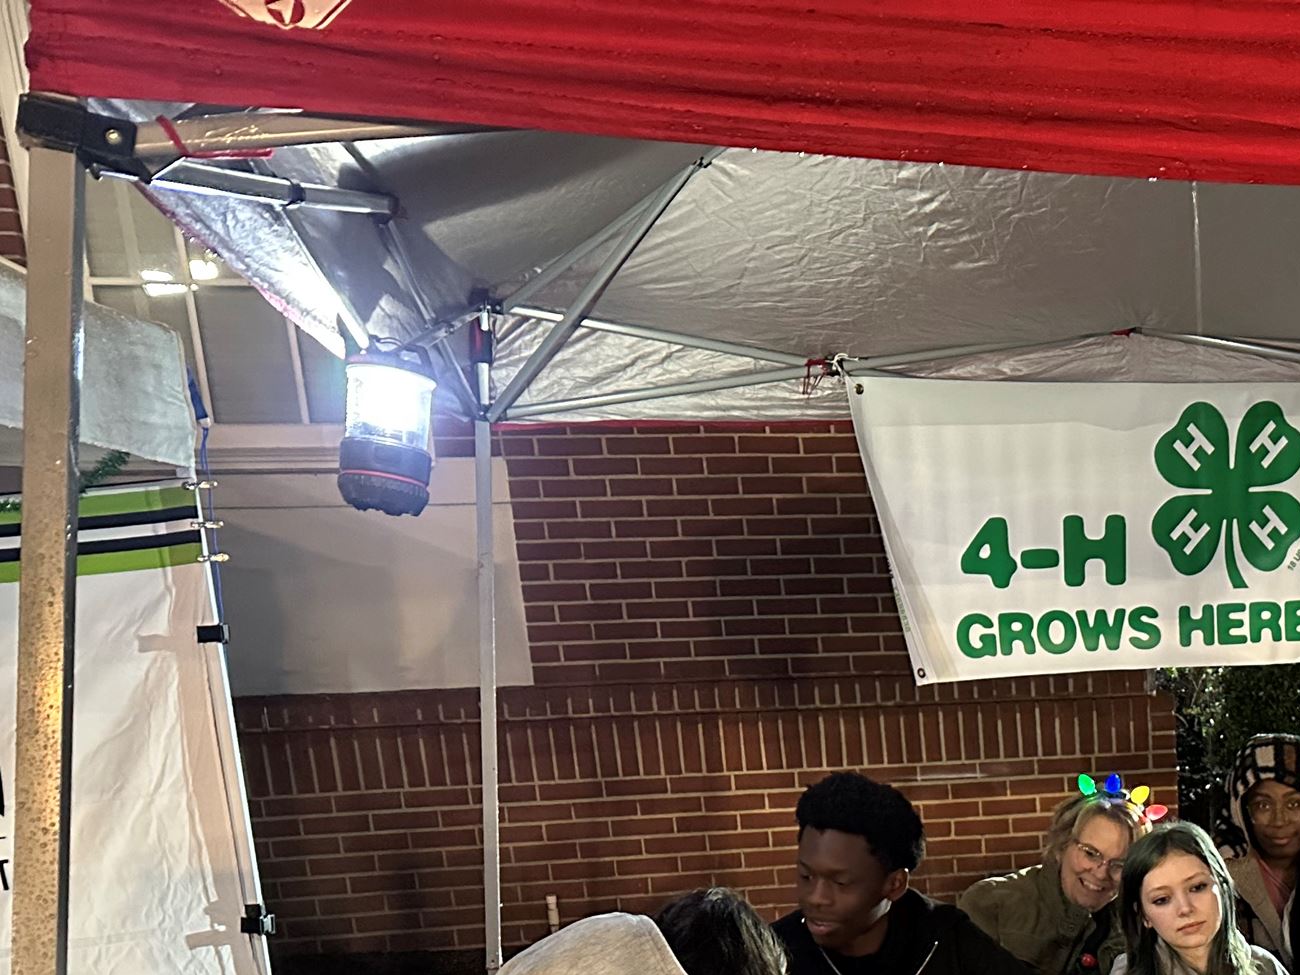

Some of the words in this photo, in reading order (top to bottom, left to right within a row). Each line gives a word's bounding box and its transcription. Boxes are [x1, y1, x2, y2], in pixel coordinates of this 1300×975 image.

[1173, 422, 1215, 471] H
[1249, 420, 1289, 468] H
[960, 514, 1127, 588] 4-H
[1170, 508, 1210, 555] H
[1249, 505, 1288, 551] H
[956, 606, 1161, 659] GROWS
